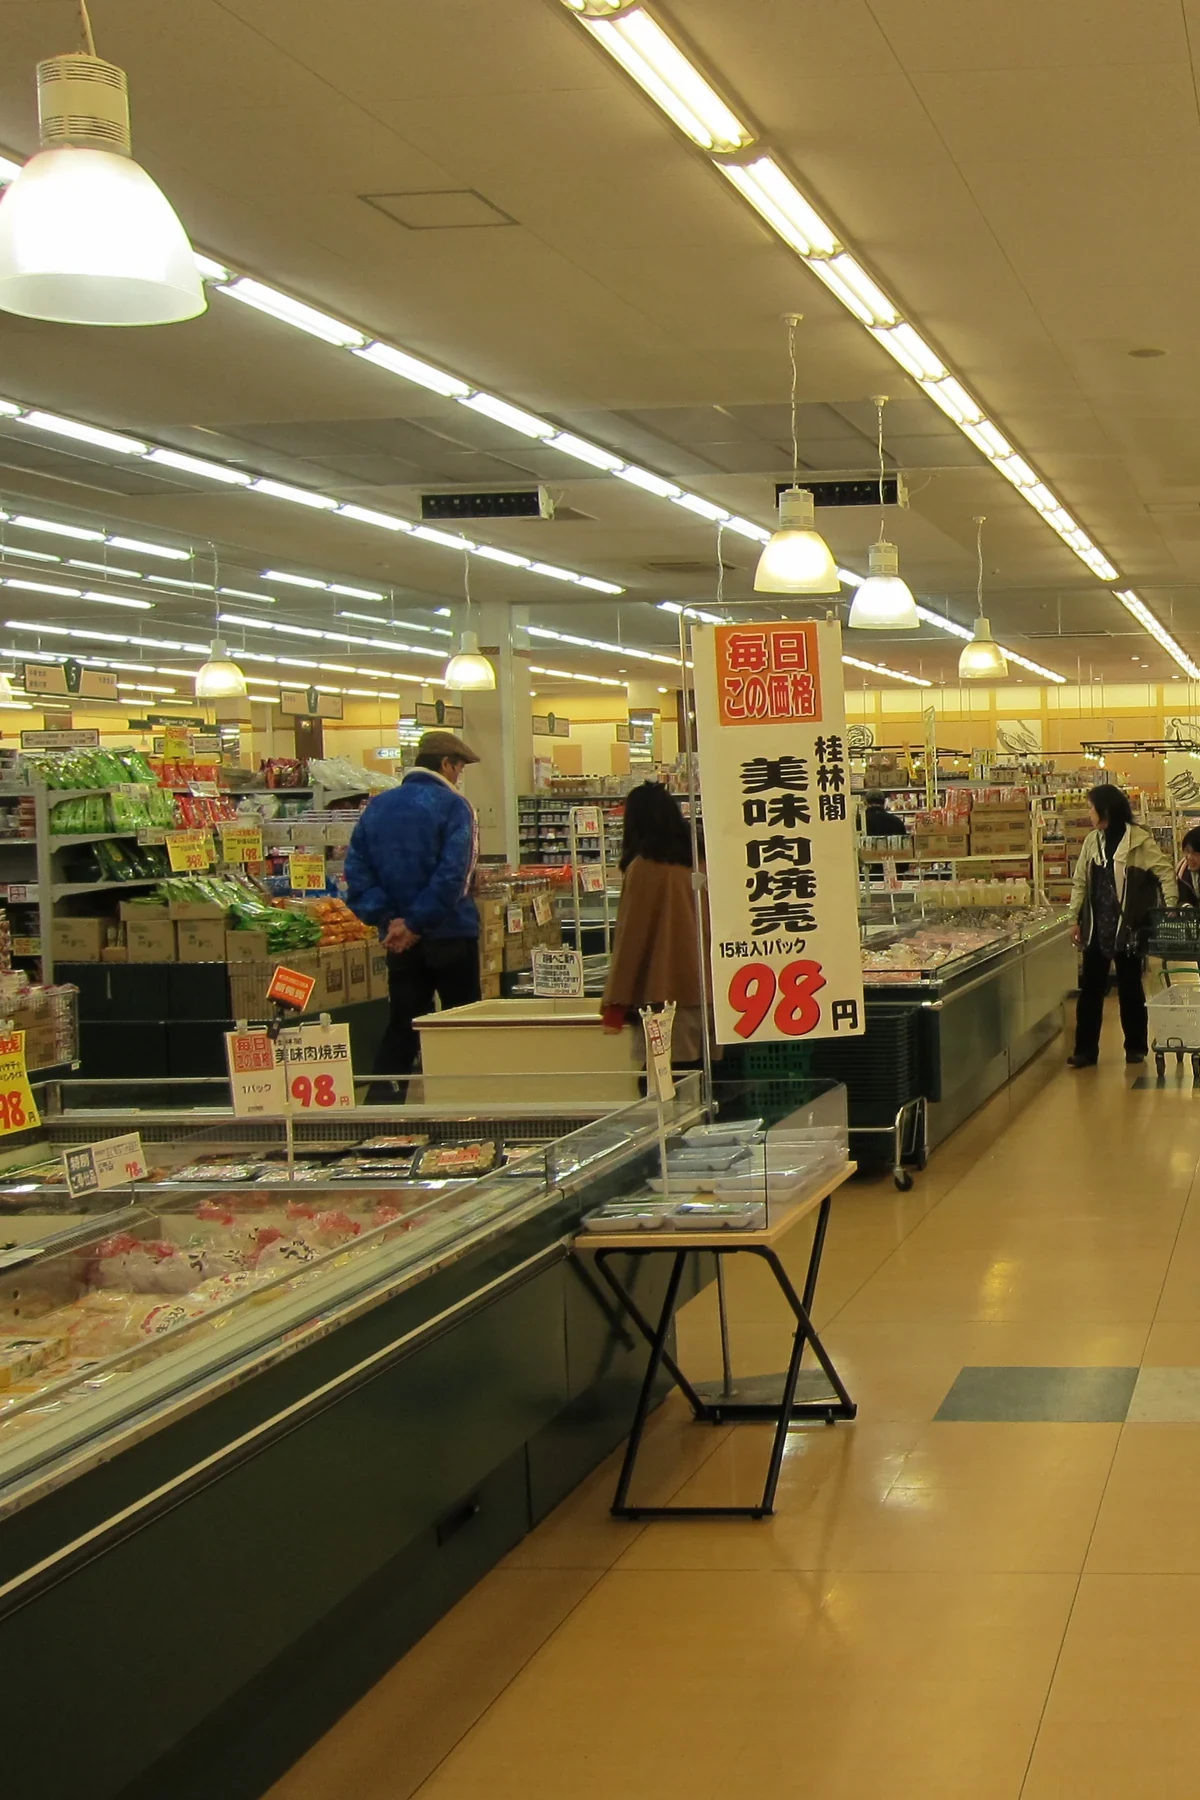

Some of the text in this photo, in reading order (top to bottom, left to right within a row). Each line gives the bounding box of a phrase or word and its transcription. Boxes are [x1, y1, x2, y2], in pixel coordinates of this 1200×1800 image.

[726, 631, 808, 672] 毎日
[724, 674, 816, 719] この価格
[814, 735, 847, 822] 桂林閣
[739, 755, 818, 936] 美味肉焼売
[719, 938, 807, 959] 15粒入1パック
[236, 1037, 267, 1052] 毎日
[291, 1074, 336, 1107] 98
